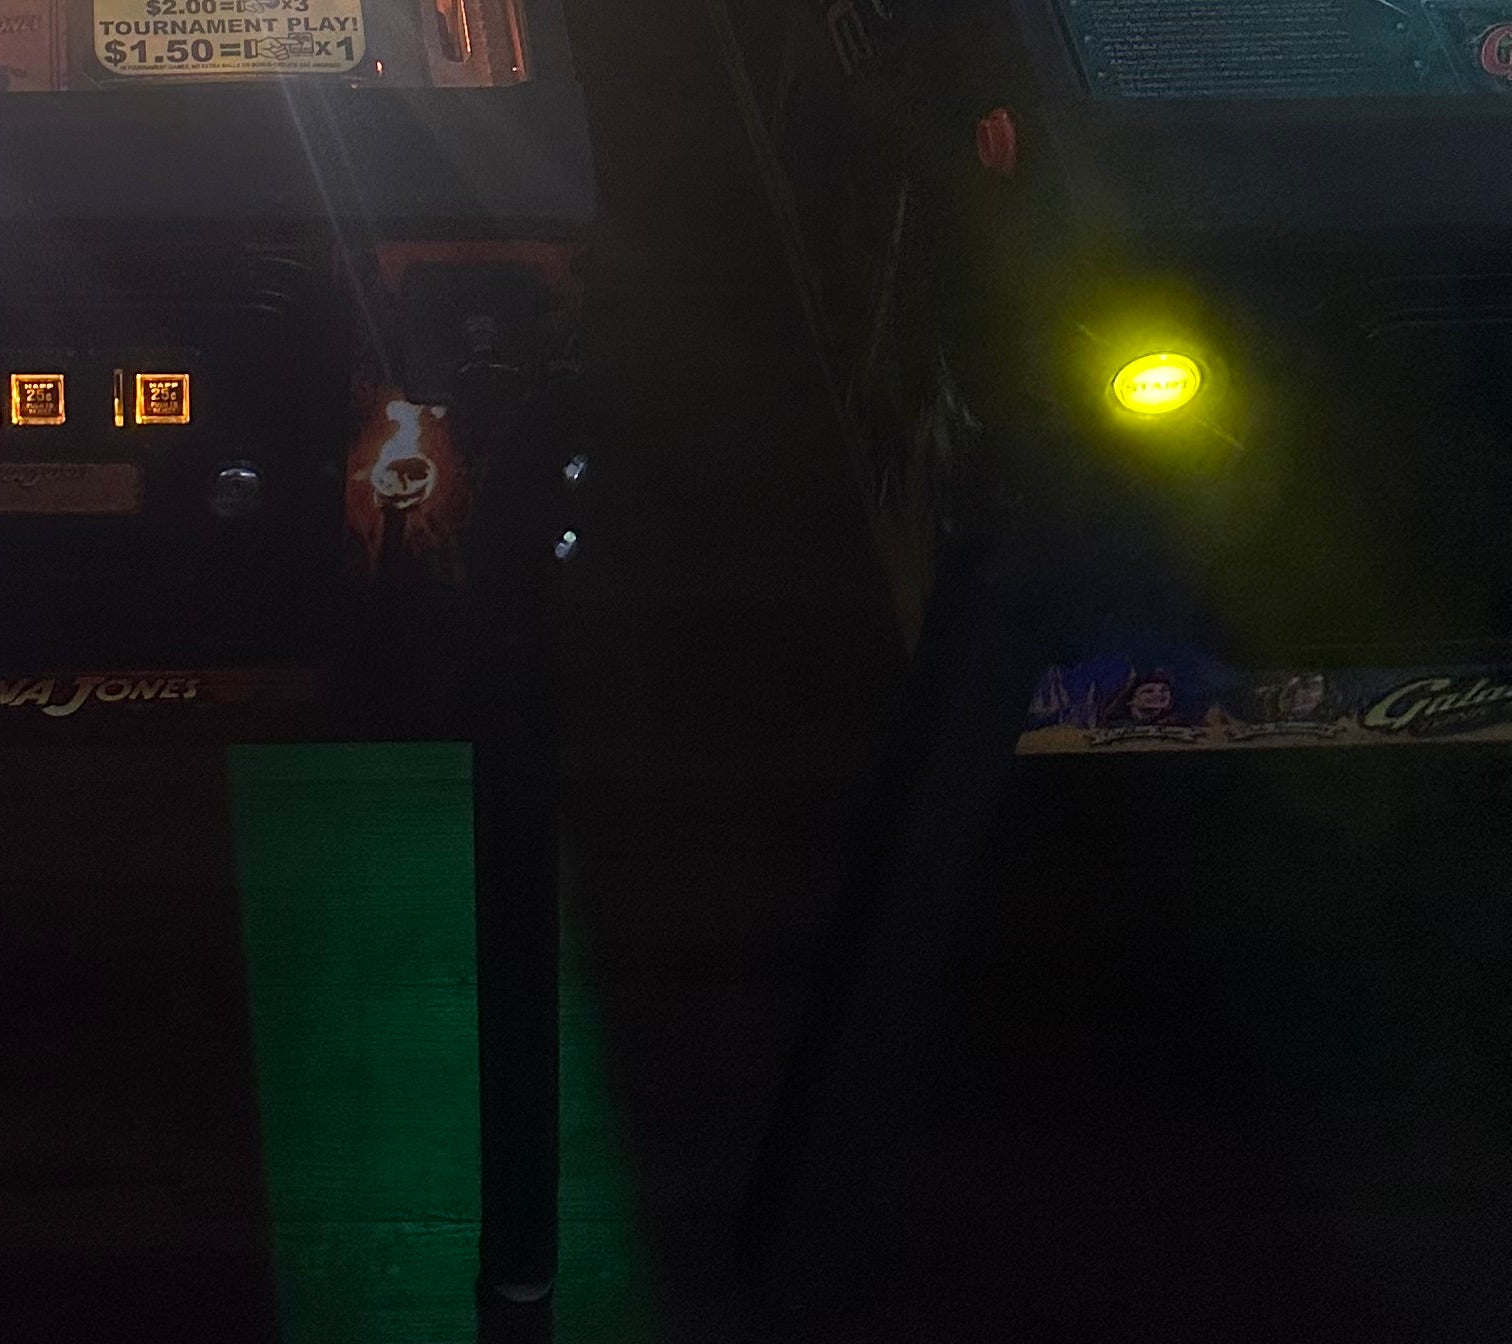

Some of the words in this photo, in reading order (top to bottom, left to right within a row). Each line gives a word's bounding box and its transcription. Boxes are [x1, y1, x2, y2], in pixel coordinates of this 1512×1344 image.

[99, 18, 278, 36] TOURNAMENT
[288, 16, 359, 32] PLAY!
[43, 676, 201, 718] JONES
